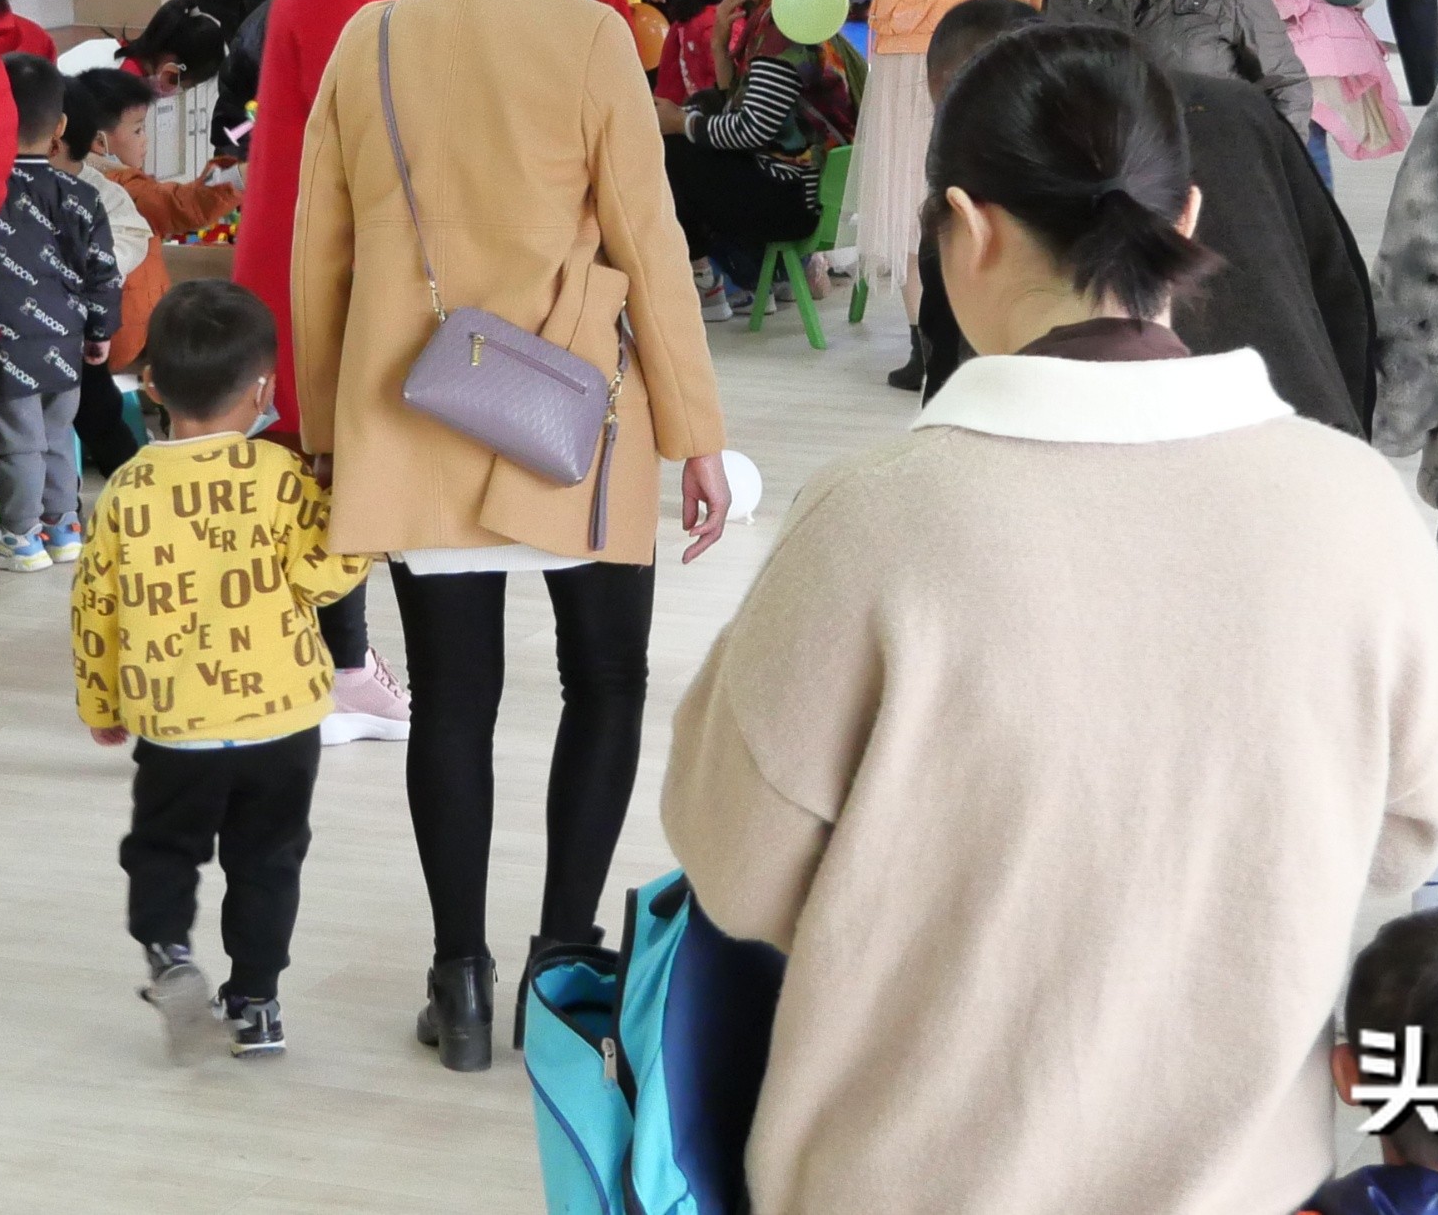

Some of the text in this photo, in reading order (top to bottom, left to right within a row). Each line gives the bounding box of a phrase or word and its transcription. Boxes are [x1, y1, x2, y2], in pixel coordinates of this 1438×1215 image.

[3, 255, 38, 286] SNOOPY
[34, 308, 69, 336] SNOOPY
[3, 361, 40, 390] SNOOPY
[172, 479, 258, 518] URE
[190, 517, 238, 553] VER
[119, 570, 198, 616] URE
[220, 554, 282, 609] OU
[196, 659, 265, 698] VER
